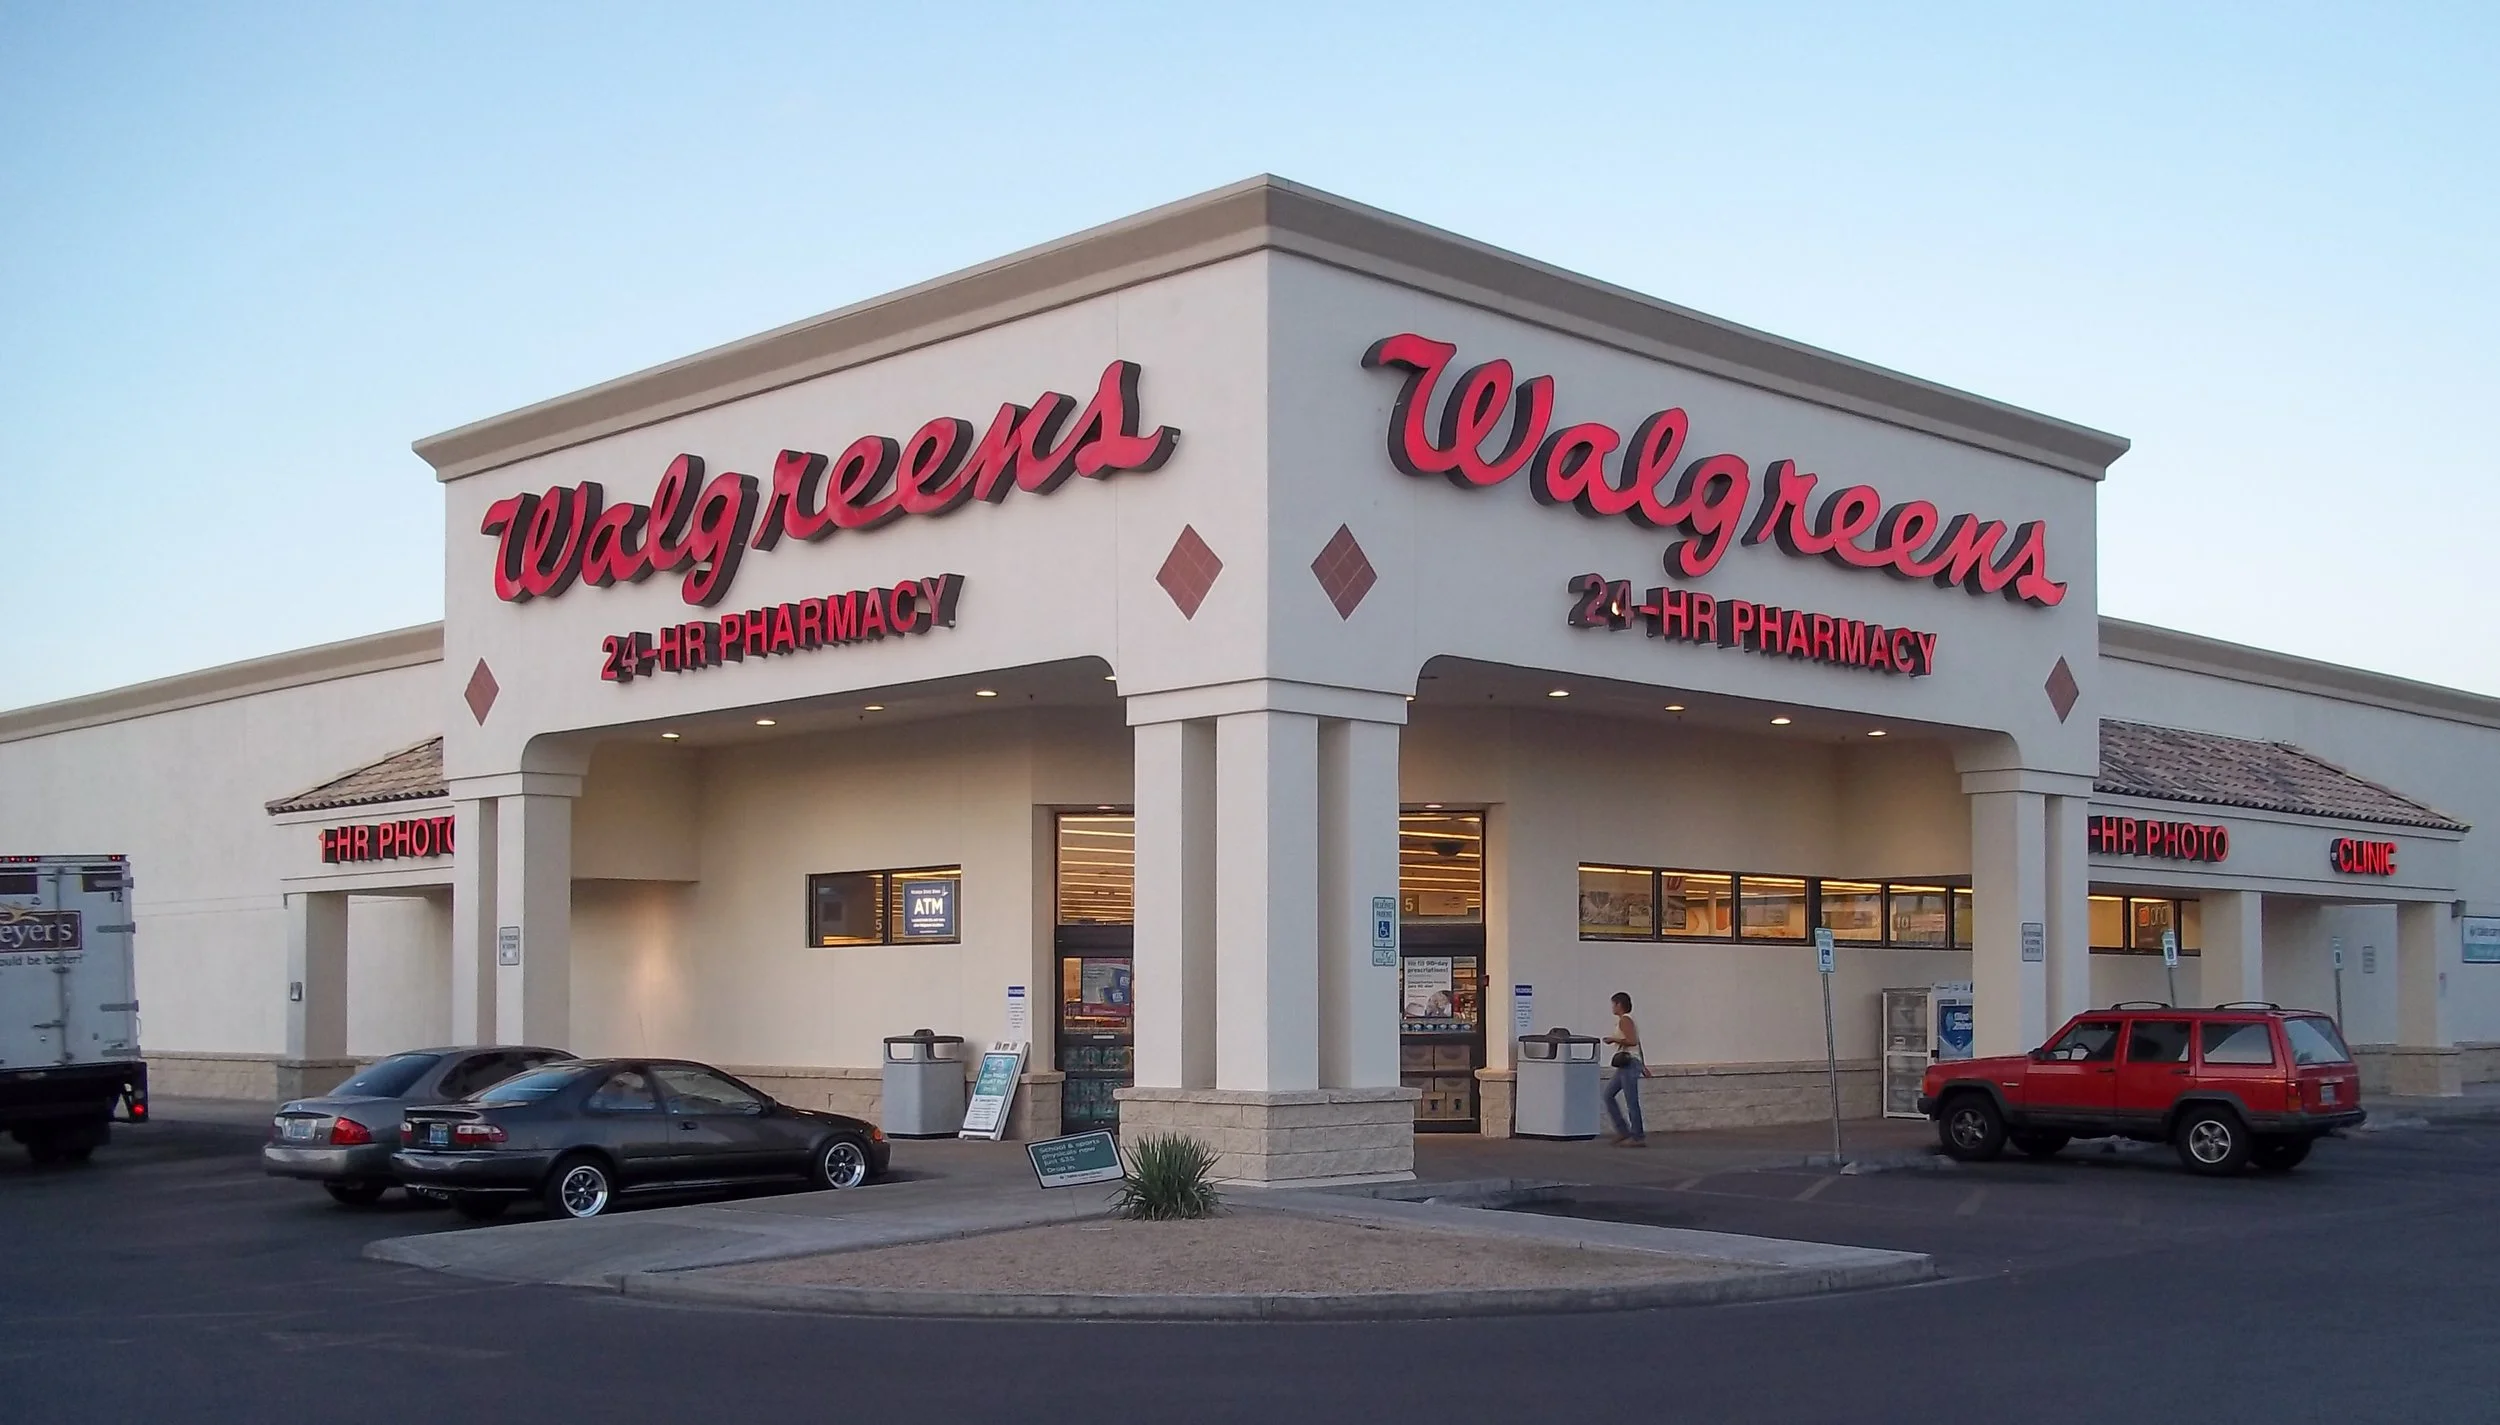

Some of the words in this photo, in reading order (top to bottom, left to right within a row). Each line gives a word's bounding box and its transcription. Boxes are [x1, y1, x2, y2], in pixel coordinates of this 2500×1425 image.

[481, 359, 1181, 608] Walgreens
[1362, 333, 2068, 607] Walgreens
[601, 621, 718, 682] 24-HR
[720, 573, 963, 661] PHARMACY
[1570, 573, 1718, 645] 24-HR
[1727, 599, 1937, 678] PHARMACY
[319, 825, 370, 864] 1-HR
[2145, 820, 2230, 863] PHOTO
[2335, 838, 2398, 877] CLINIC
[109, 891, 123, 902] 12
[913, 897, 944, 916] ATM
[1404, 897, 1414, 912] 5
[1039, 1144, 1066, 1154] School
[1075, 1139, 1101, 1148] sports
[1041, 1149, 1077, 1160] physicals
[1046, 1165, 1066, 1174] Drop
